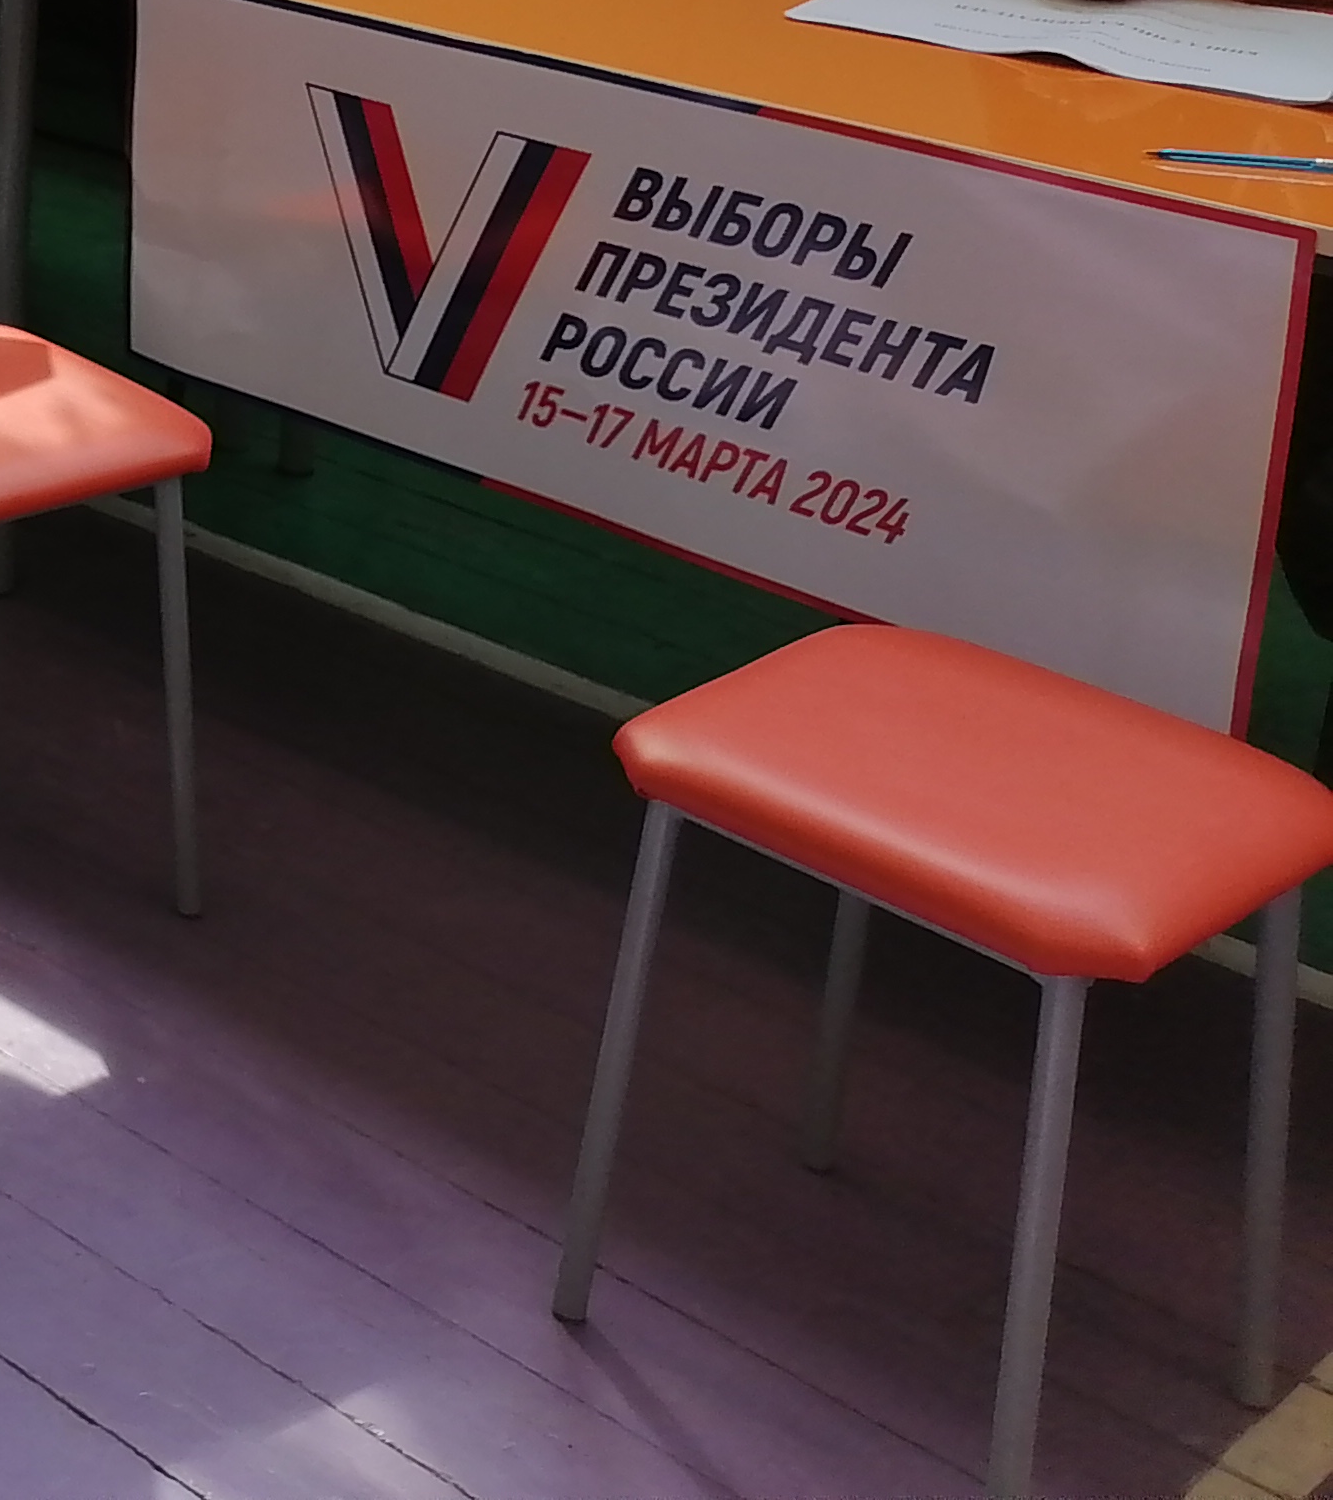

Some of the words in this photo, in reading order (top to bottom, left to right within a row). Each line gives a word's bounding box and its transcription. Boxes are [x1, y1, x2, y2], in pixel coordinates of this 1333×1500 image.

[613, 166, 913, 289] ВЫБОРЫ
[540, 313, 798, 430] РОССИИ
[575, 241, 995, 404] ПРЕЗИДЕНТА
[632, 419, 788, 505] МАРТА
[789, 470, 911, 545] 2024
